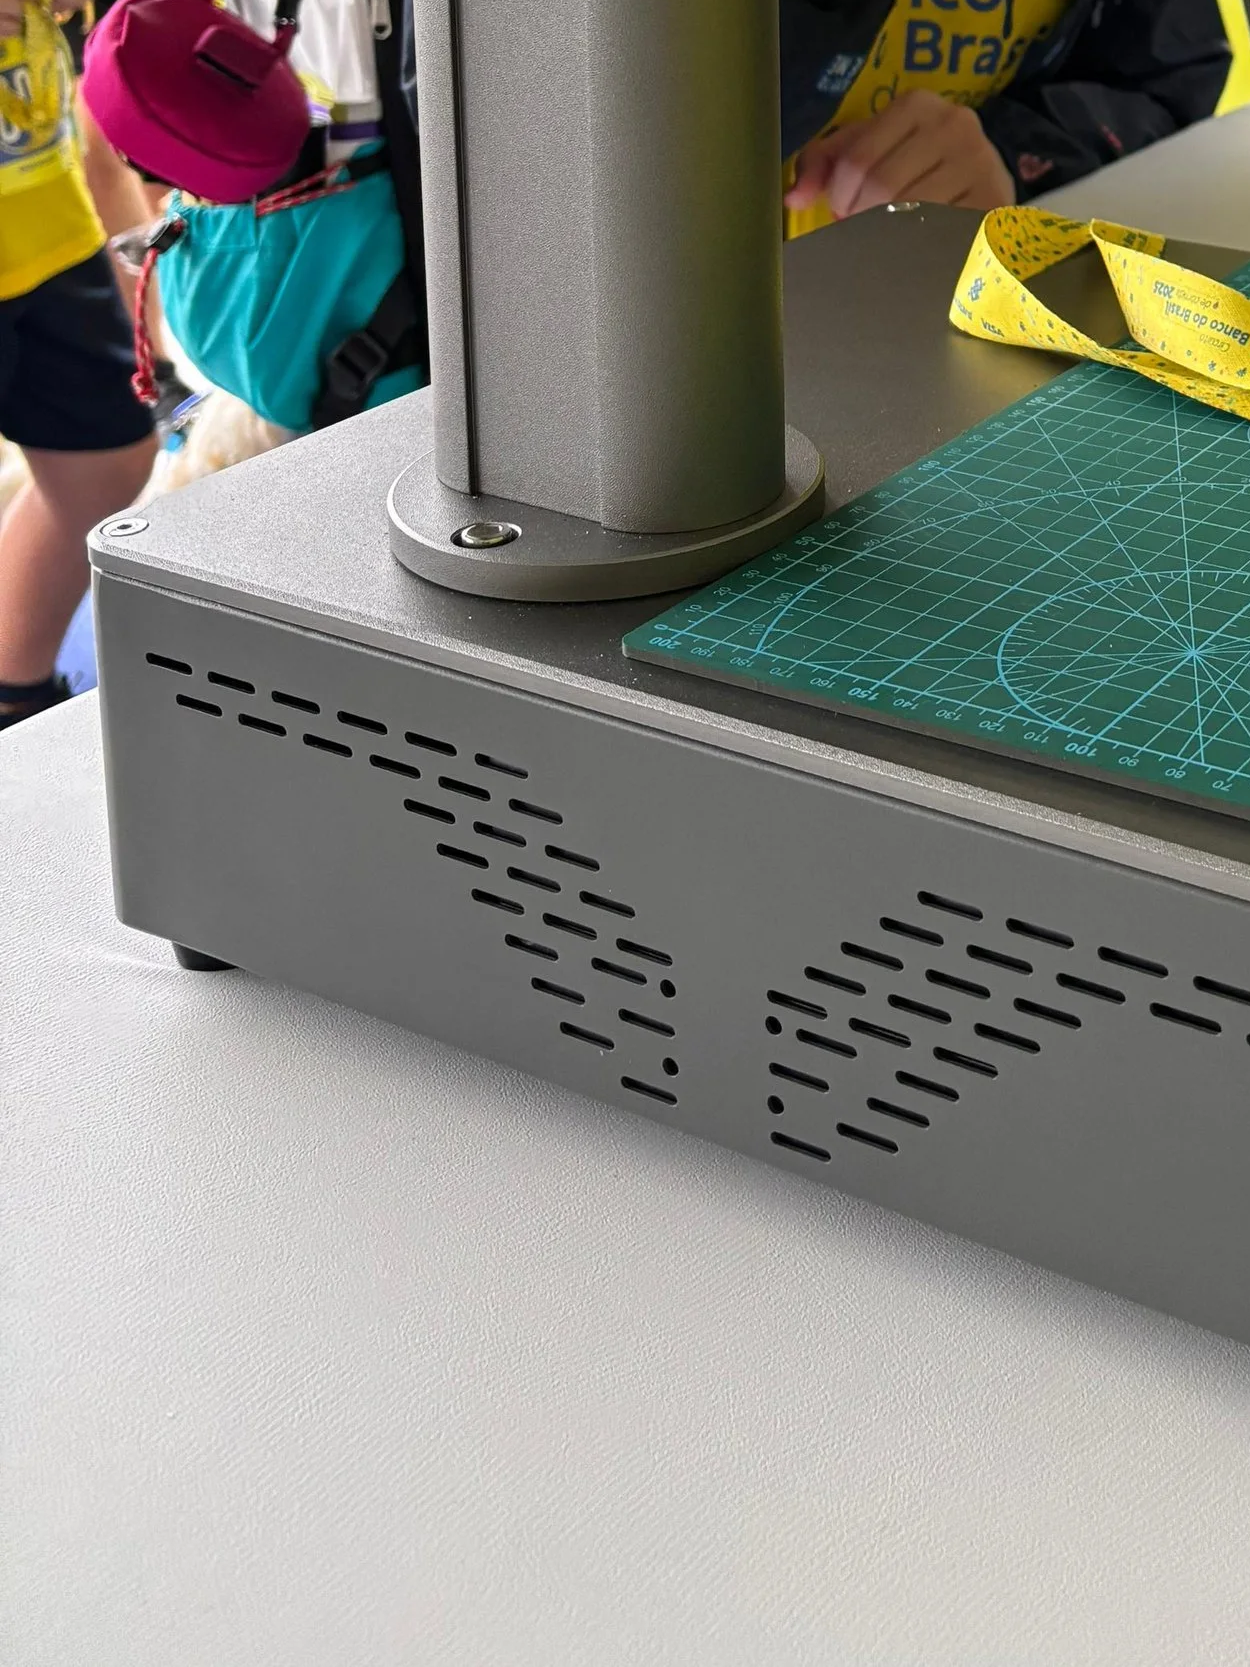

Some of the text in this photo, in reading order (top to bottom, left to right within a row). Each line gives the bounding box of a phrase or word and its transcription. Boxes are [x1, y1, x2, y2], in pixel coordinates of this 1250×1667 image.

[1153, 280, 1176, 299] 2025
[1165, 301, 1250, 346] Banco do Brasil
[918, 460, 940, 471] 100
[849, 505, 866, 514] 70
[919, 517, 936, 525] 70
[795, 536, 815, 546] 50
[771, 552, 788, 562] 40
[742, 569, 761, 579] 30
[713, 586, 732, 597] 20
[773, 592, 794, 606] 100
[684, 604, 702, 613] 10
[654, 623, 669, 631] 0
[649, 636, 682, 650] 200
[690, 646, 717, 660] 190
[729, 656, 755, 669] 180
[769, 666, 797, 679] 170
[810, 677, 836, 689] 160
[847, 687, 880, 702] 150
[893, 698, 919, 711] 140
[936, 709, 963, 722] 130
[979, 719, 1007, 733] 120
[1023, 731, 1050, 744] 110
[1064, 743, 1098, 757] 100
[1118, 755, 1140, 767] 90
[1165, 767, 1186, 779] 80
[1212, 780, 1234, 792] 70
